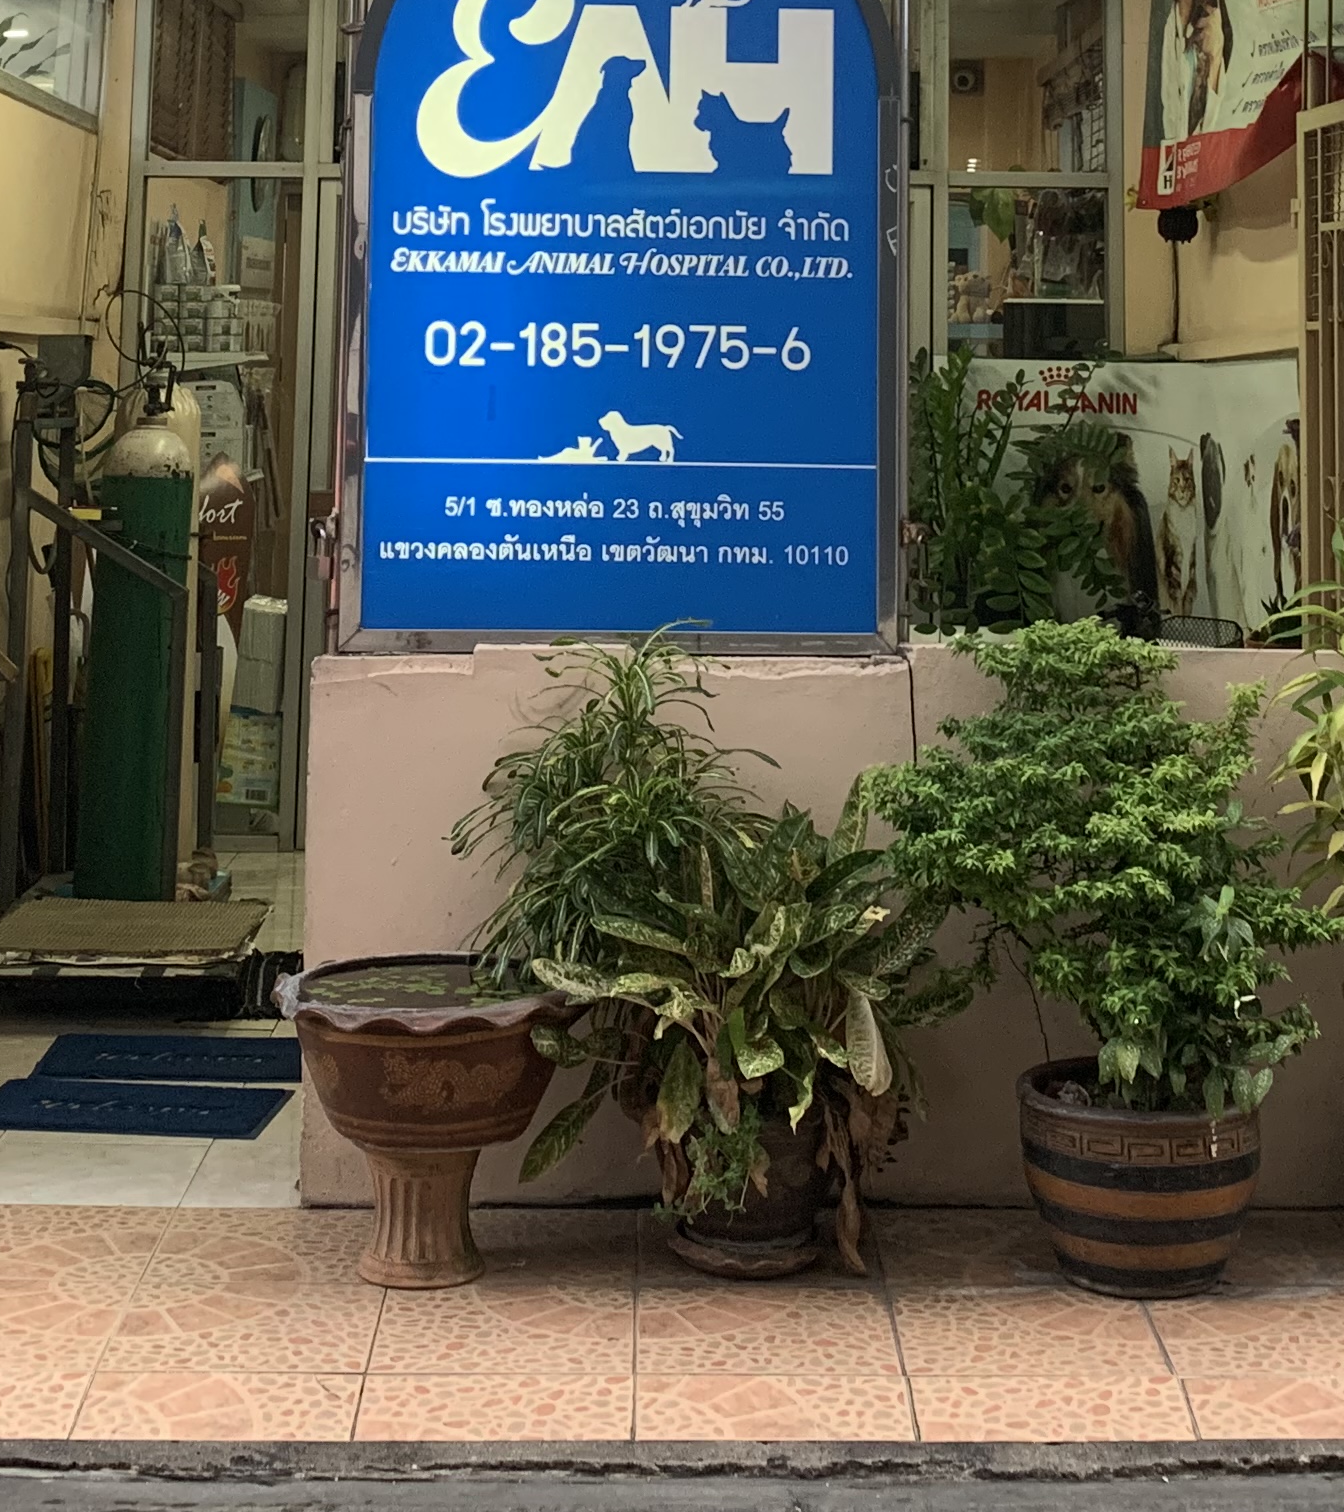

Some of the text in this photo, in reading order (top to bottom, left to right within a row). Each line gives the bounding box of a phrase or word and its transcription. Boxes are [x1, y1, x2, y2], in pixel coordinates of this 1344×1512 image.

[392, 197, 850, 242] บริษัท โรงพยาบาลสัตว์เอกมัย จำกัด
[390, 246, 854, 282] EKKAMAI ANIMAL HOSPITAL CO.,LTD.
[424, 320, 812, 371] 02-185-1975-6
[444, 492, 785, 528] 5/1 ซ.ทองหล่อ 23 ถ.สุขุมวิท 55
[379, 534, 849, 566] แขวงคลองตันเหนือ เขตวัฒนา กทม. 10110
